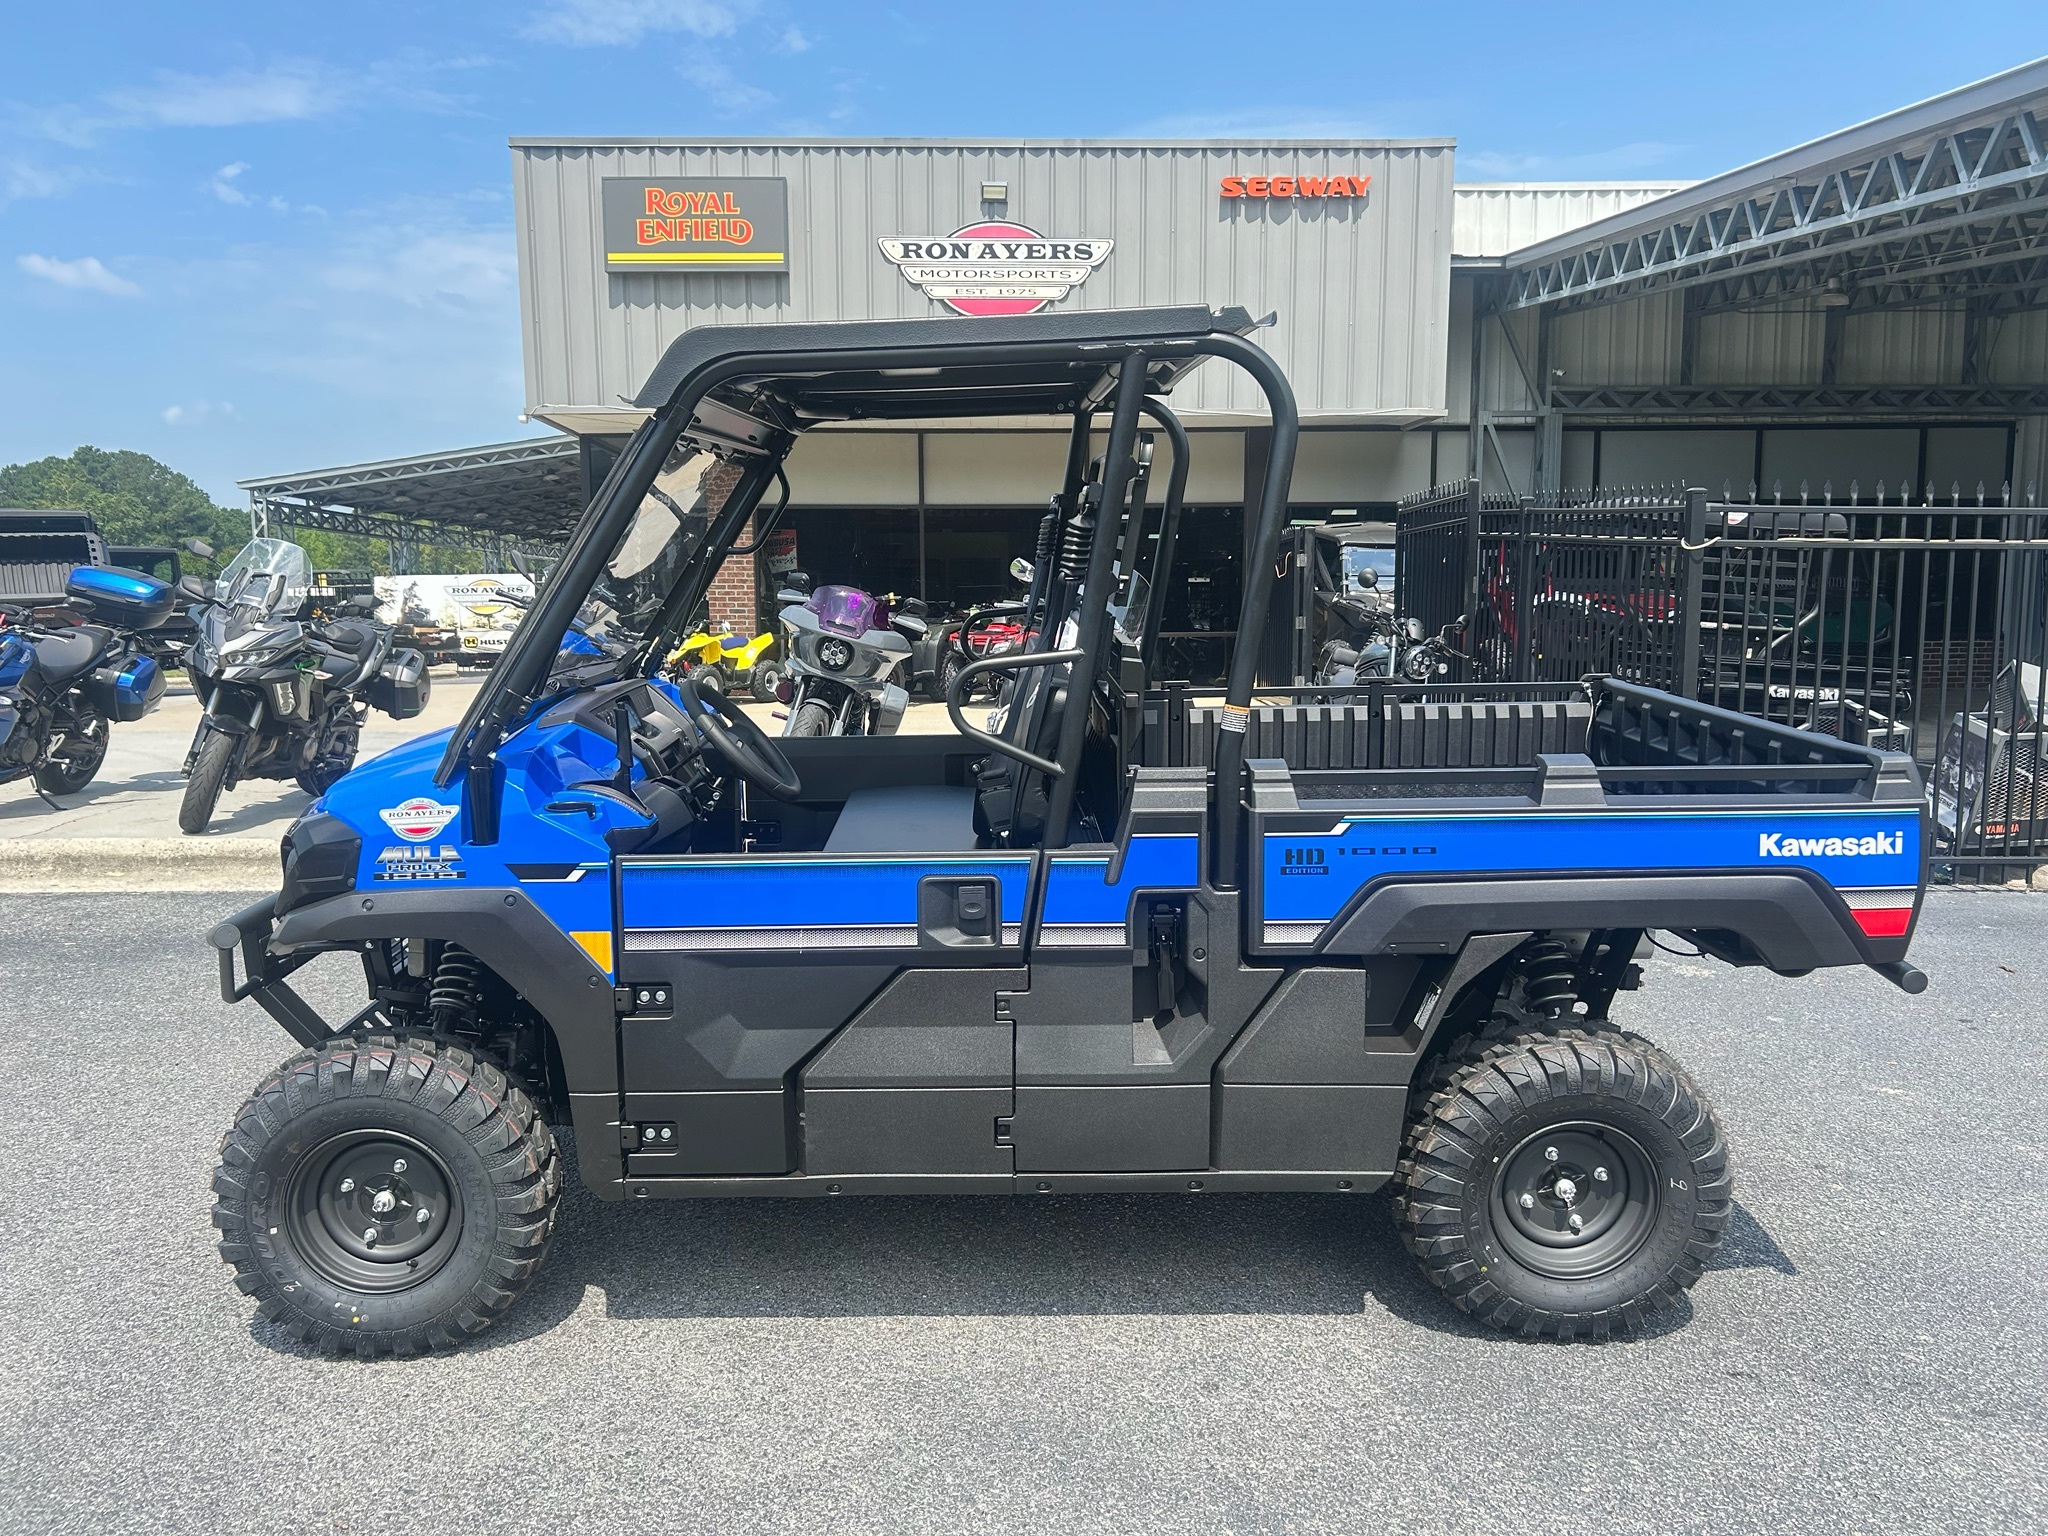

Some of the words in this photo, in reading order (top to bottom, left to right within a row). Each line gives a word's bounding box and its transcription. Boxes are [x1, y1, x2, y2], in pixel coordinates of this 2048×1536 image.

[1220, 176, 1372, 197] SEGWAY
[645, 187, 740, 217] ROYAL
[636, 218, 753, 246] ENFIELD
[900, 242, 972, 259] RON
[977, 243, 1094, 260] AYERS
[920, 269, 1072, 279] MOTORSPORTS
[414, 809, 452, 817] AYERS
[1759, 831, 1904, 857] Kawasaki
[375, 845, 464, 864] MULE
[1285, 848, 1325, 865] HD
[1337, 846, 1437, 855] 1000
[382, 872, 458, 880] 1000
[251, 1171, 294, 1285] DURO
